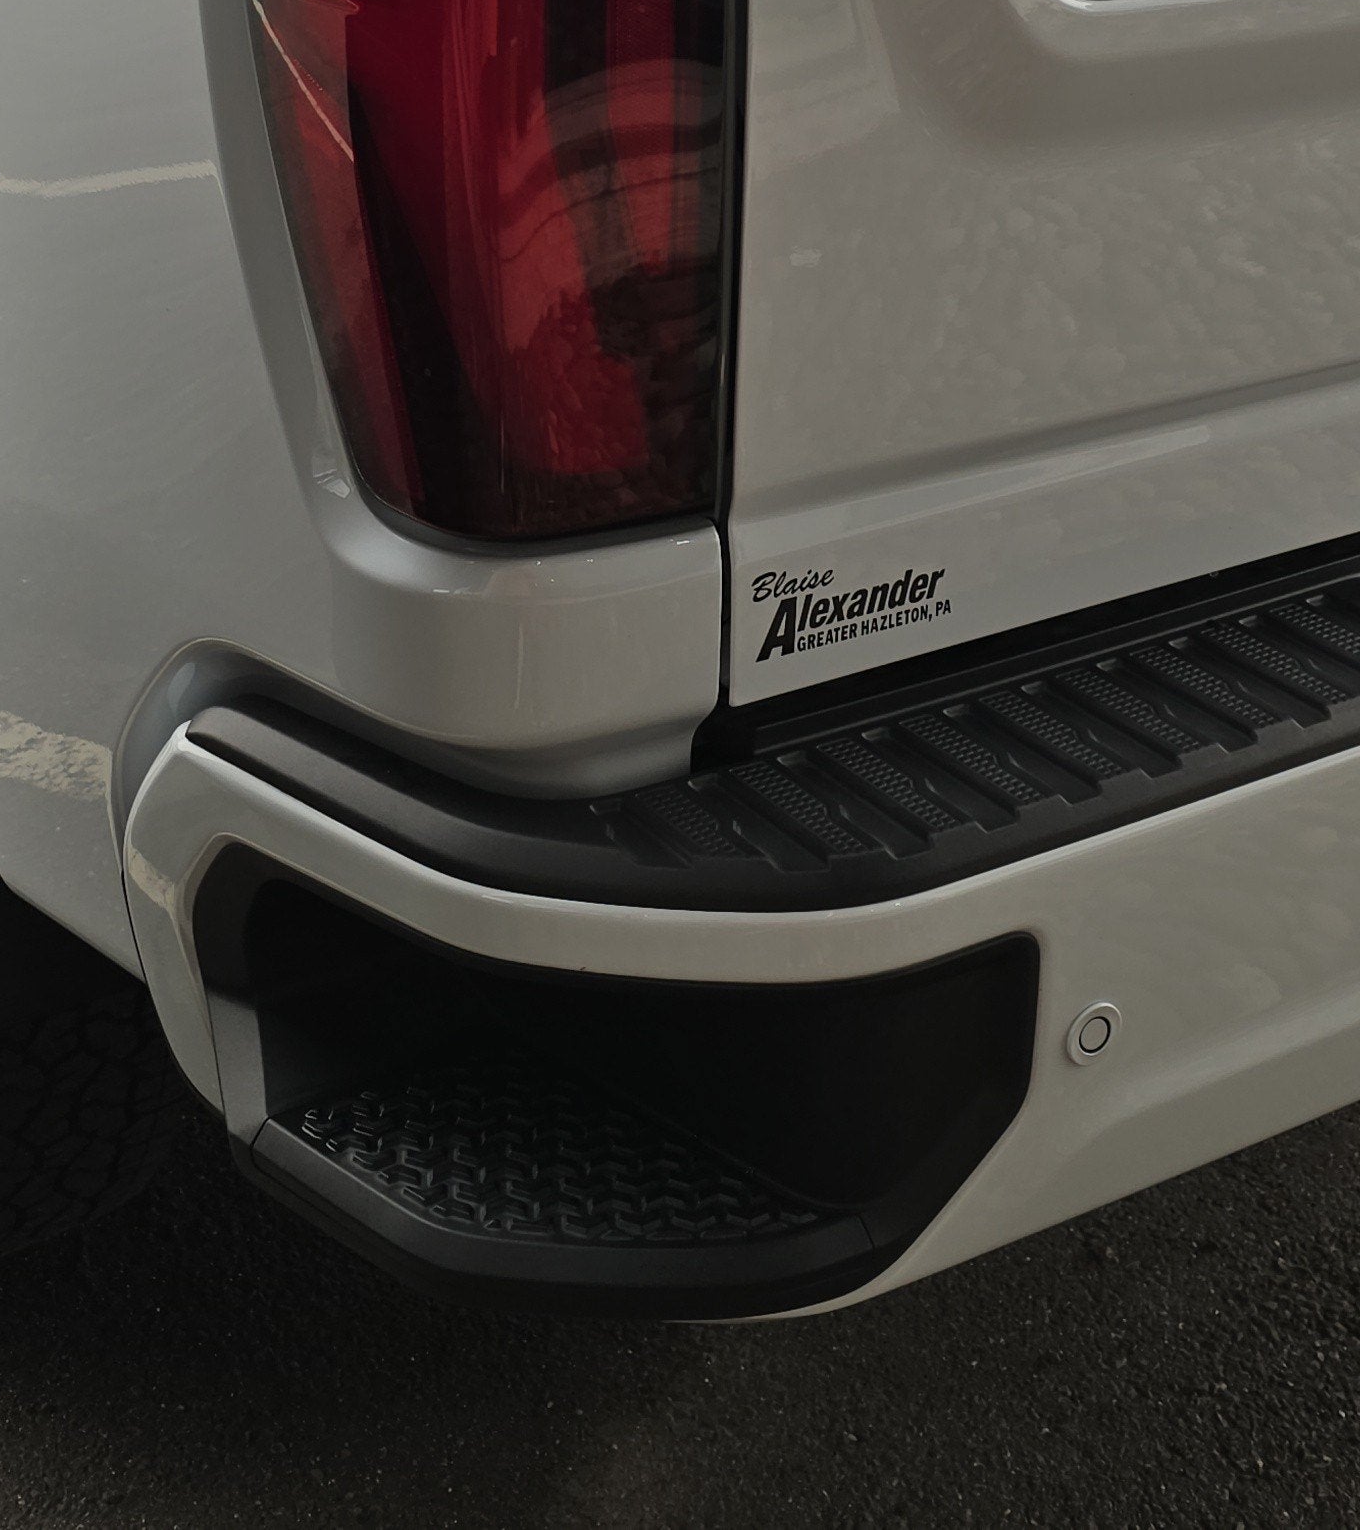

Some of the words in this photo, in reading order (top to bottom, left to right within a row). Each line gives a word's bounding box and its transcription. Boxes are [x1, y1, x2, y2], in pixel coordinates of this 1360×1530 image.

[751, 569, 835, 603] Blaise
[750, 568, 946, 663] Alexander
[796, 622, 858, 652] GREATER
[859, 603, 933, 637] HAZLETON,
[935, 599, 952, 617] PA
